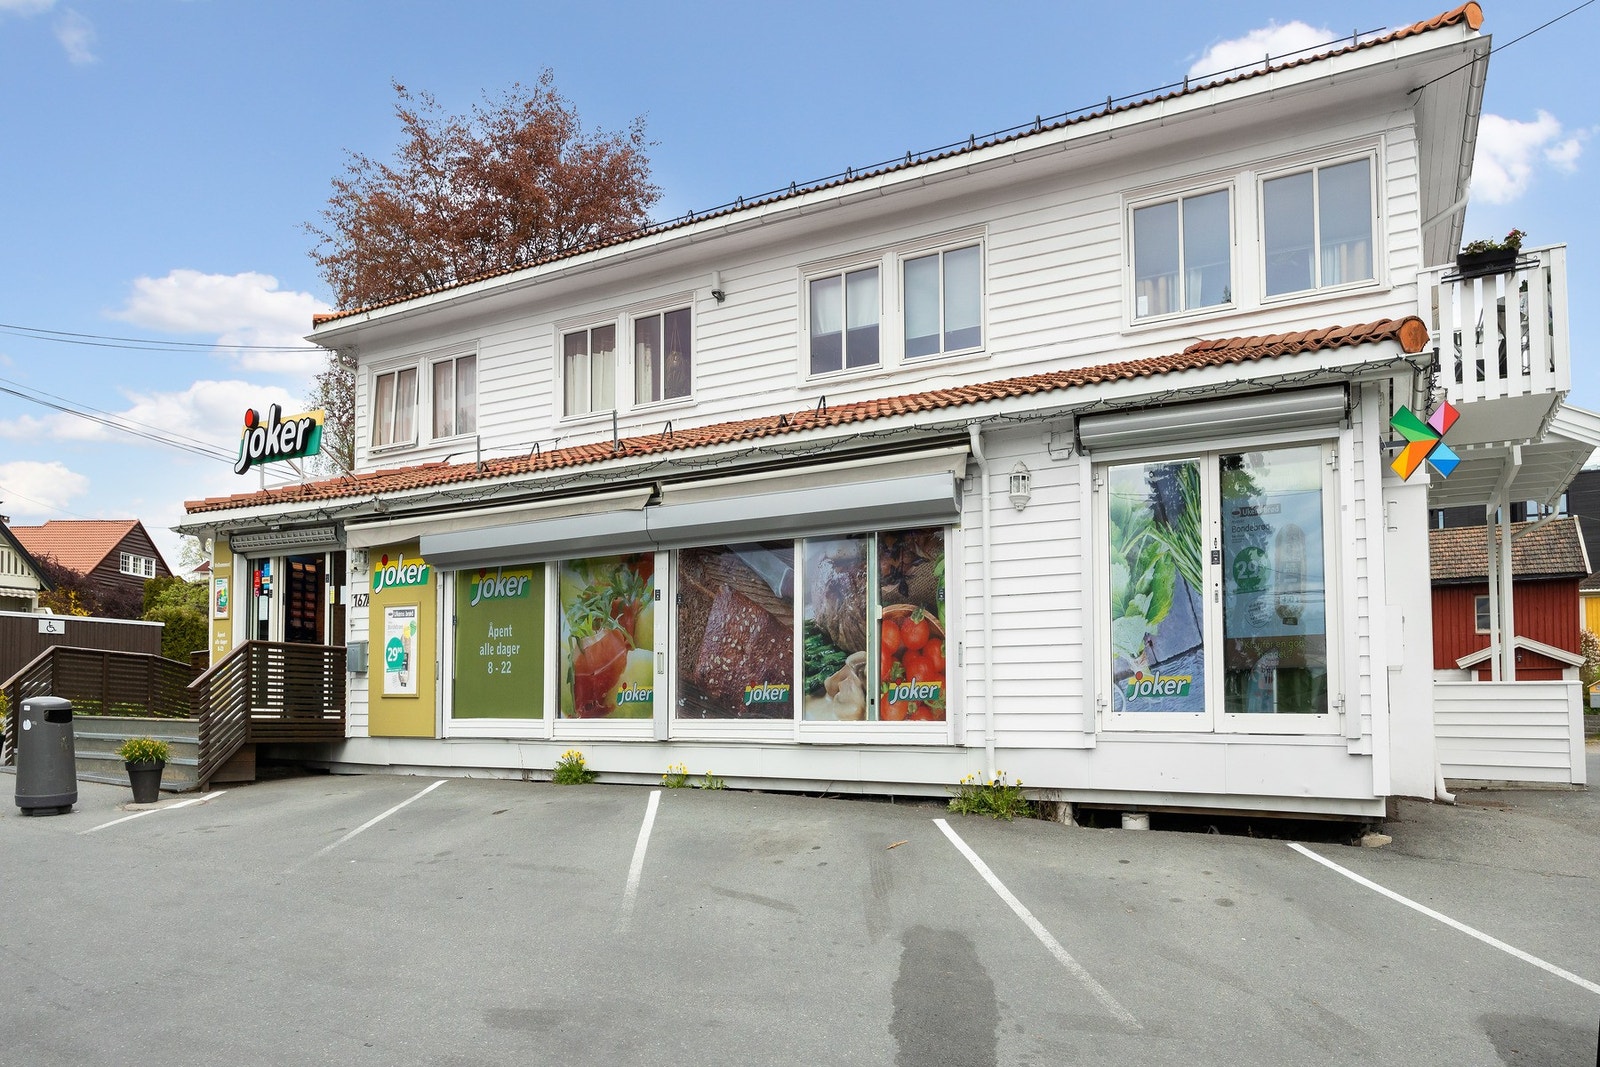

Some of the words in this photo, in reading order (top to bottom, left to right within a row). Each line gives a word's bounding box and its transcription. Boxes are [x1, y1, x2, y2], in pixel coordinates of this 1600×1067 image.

[234, 403, 315, 474] joker
[374, 553, 428, 594] joker
[1236, 561, 1258, 579] 29
[471, 567, 528, 607] joker
[487, 622, 513, 640] Åpent
[387, 647, 398, 662] 29
[479, 644, 494, 656] alle
[496, 643, 520, 657] dager
[487, 662, 493, 674] 8
[501, 661, 512, 674] 22
[618, 682, 652, 706] joker
[745, 680, 788, 706] joker
[889, 677, 940, 704] joker
[1128, 671, 1188, 702] joker
